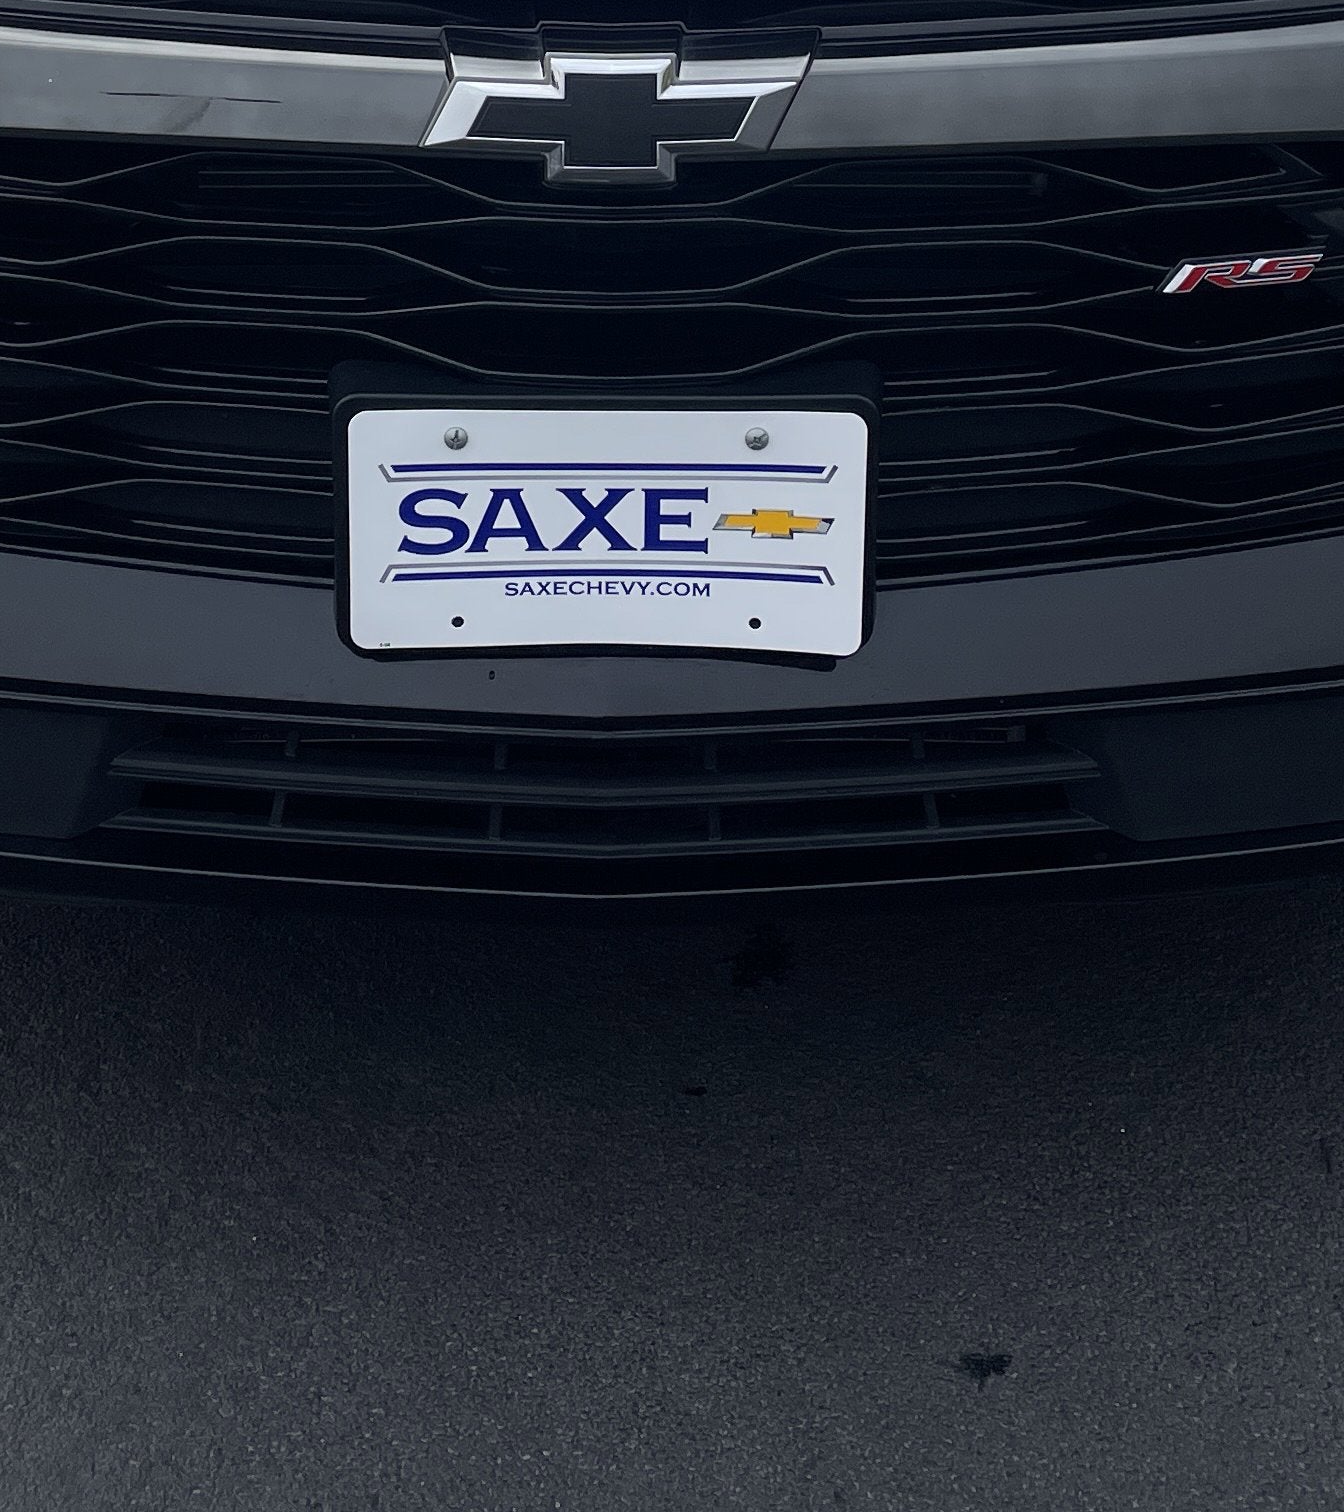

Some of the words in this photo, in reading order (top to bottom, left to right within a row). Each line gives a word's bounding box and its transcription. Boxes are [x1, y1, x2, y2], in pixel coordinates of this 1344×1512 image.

[1163, 254, 1323, 293] RS
[397, 487, 709, 555] SAXE
[504, 580, 711, 598] SAXECHEVY.COM
